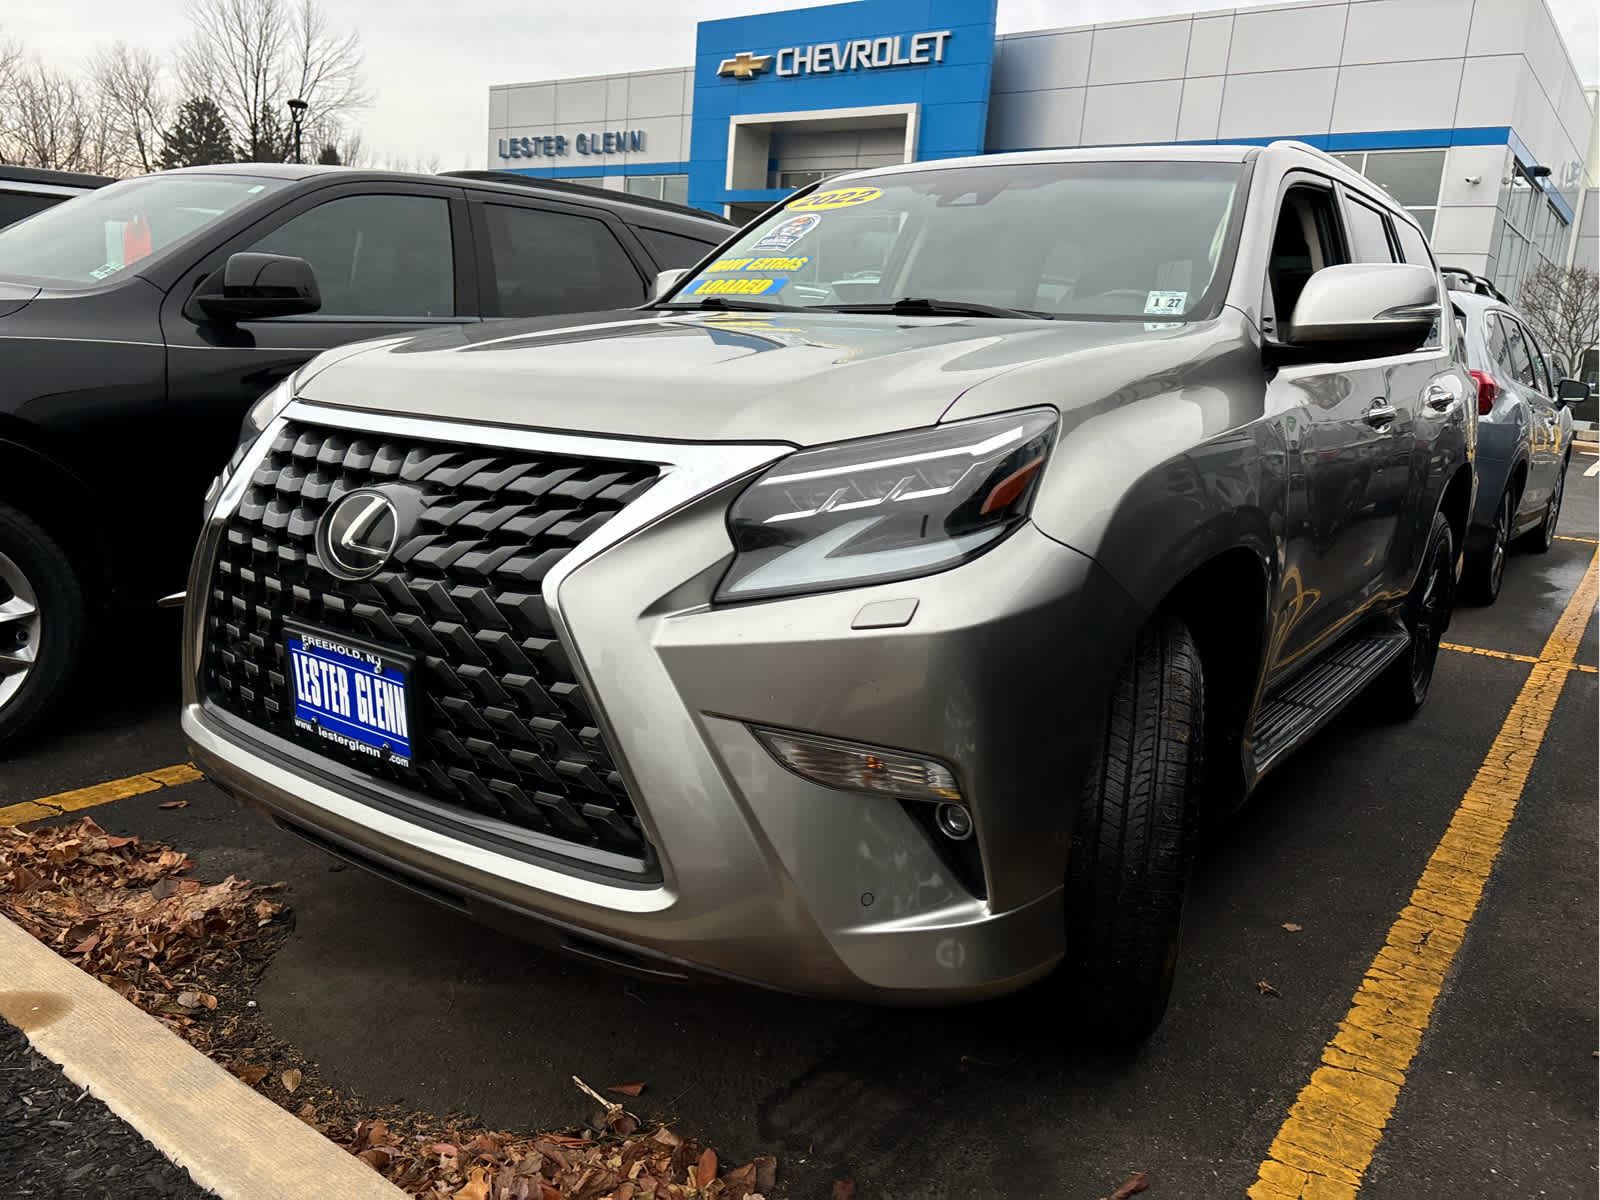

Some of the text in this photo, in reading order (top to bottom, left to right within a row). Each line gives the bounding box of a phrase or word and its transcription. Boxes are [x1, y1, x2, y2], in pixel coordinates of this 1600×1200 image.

[776, 30, 952, 77] CHEVROLET
[498, 130, 645, 159] LESTER GLENN
[790, 190, 878, 208] 2022
[746, 257, 809, 271] EXTRAS
[694, 279, 774, 295] LOADED
[1167, 298, 1182, 308] 27
[301, 634, 382, 666] FREEHOLD, NJ
[292, 652, 408, 739] LESTER GLENN
[318, 725, 381, 758] lesterglenn
